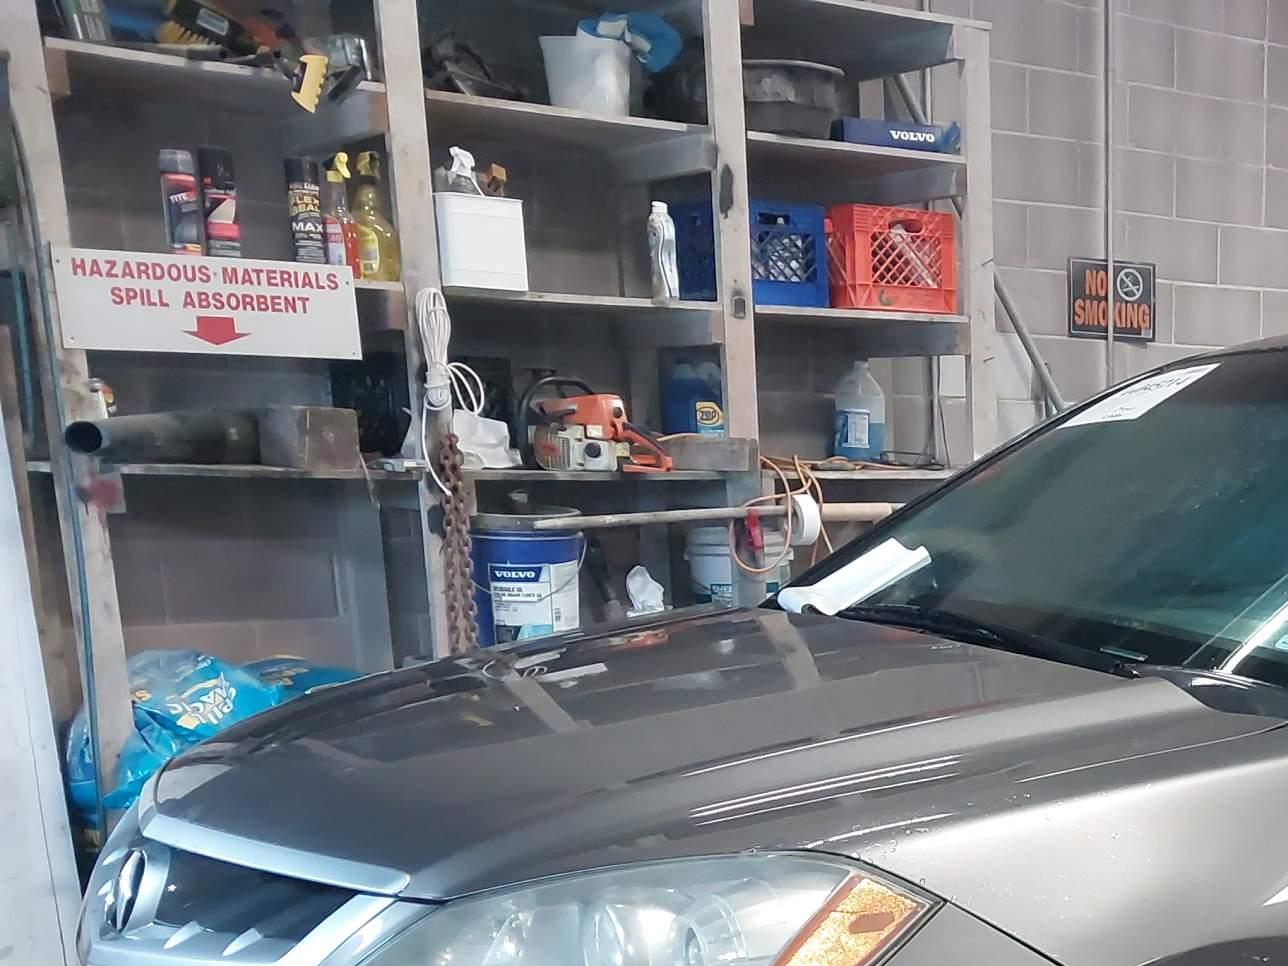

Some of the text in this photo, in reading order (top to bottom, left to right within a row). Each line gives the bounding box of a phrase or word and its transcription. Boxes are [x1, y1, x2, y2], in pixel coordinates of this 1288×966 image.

[889, 129, 936, 143] VOLVO
[292, 221, 324, 233] MAX
[71, 257, 340, 291] HAZARDOUS MATERIALS
[1085, 269, 1108, 297] NO
[110, 286, 310, 314] SPILL ABSORBENT
[1074, 298, 1150, 329] SMOKING
[494, 570, 536, 579] VOLVO
